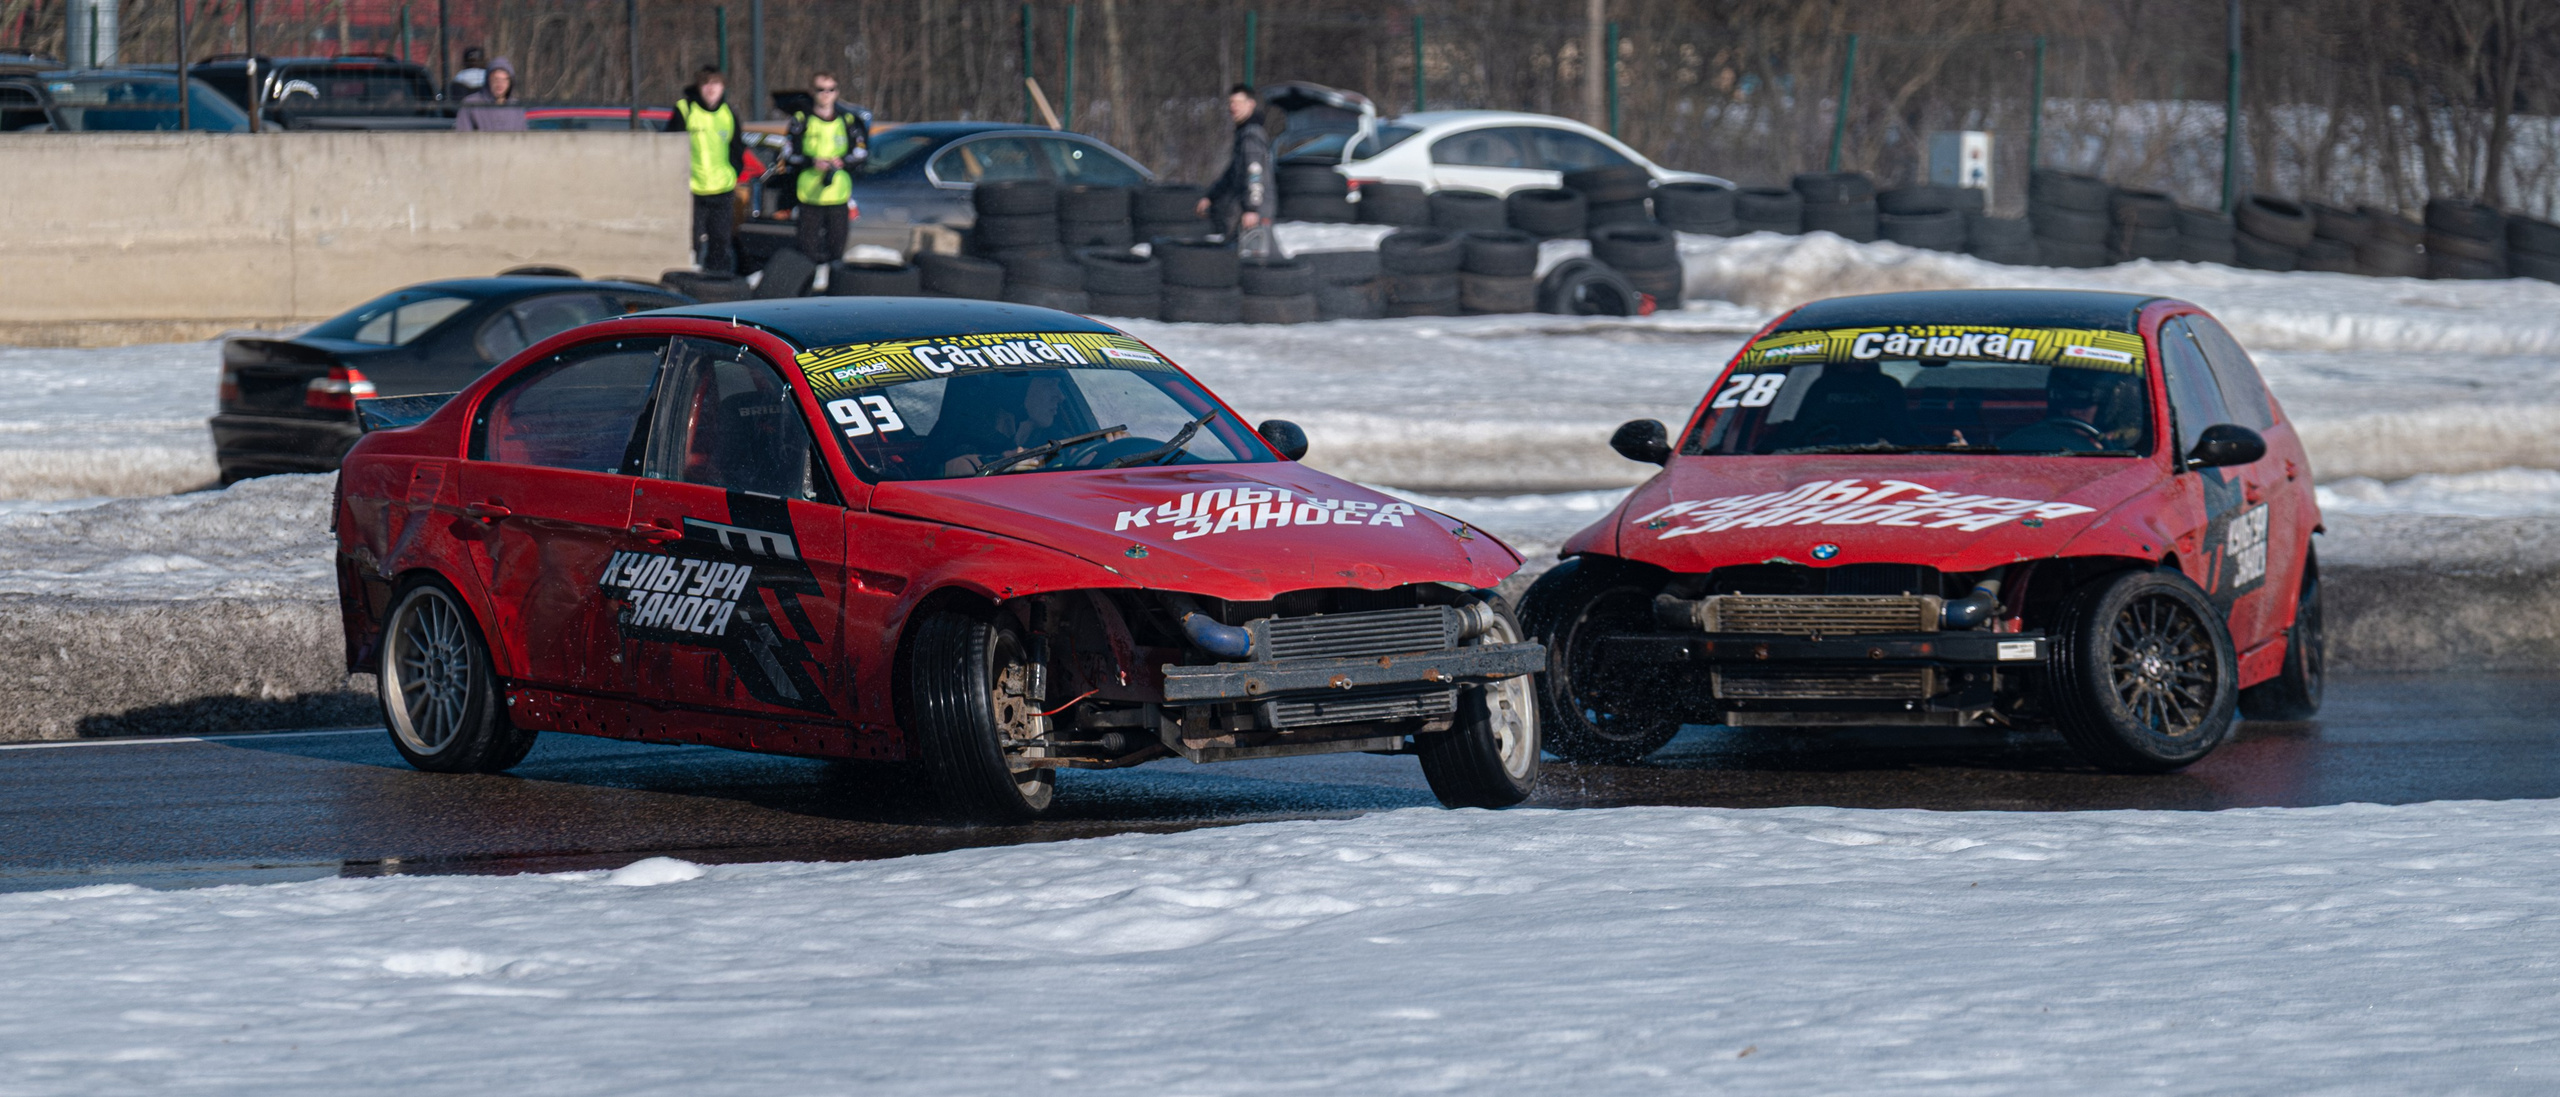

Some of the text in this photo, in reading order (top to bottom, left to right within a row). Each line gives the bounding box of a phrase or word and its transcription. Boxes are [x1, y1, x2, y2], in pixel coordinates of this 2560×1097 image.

[834, 361, 888, 380] EXHAUST
[1712, 373, 1787, 409] 28
[827, 395, 904, 438] 93
[1114, 487, 1416, 531] КУЛЬТУРА
[1172, 502, 1404, 540] ЗАНОСА
[1632, 479, 2097, 524] КУЛЬТУРА
[1657, 502, 2024, 540] ЗАНОСА
[600, 550, 753, 600] КУЛЬТУРА
[627, 590, 737, 636] ЗАНОСА
